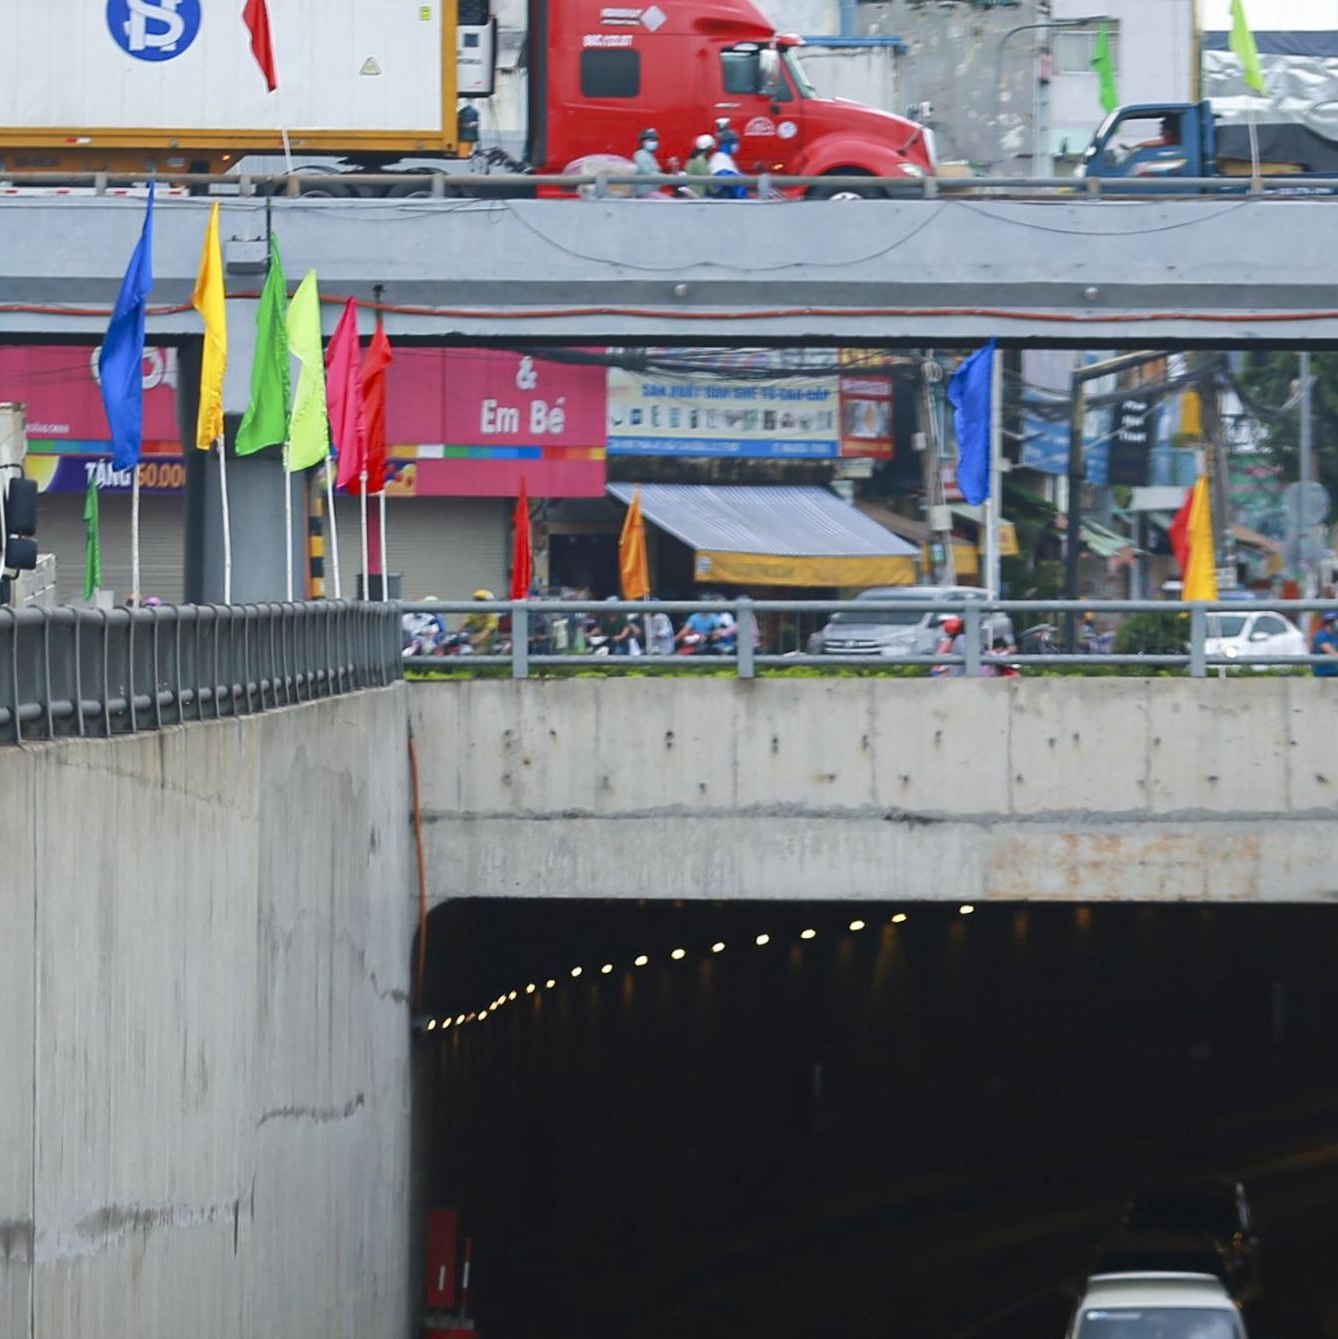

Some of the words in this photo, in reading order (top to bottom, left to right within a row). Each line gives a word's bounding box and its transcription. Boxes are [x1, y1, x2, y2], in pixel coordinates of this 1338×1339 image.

[516, 355, 538, 391] &
[481, 399, 518, 433] Em
[530, 396, 565, 434] Bé
